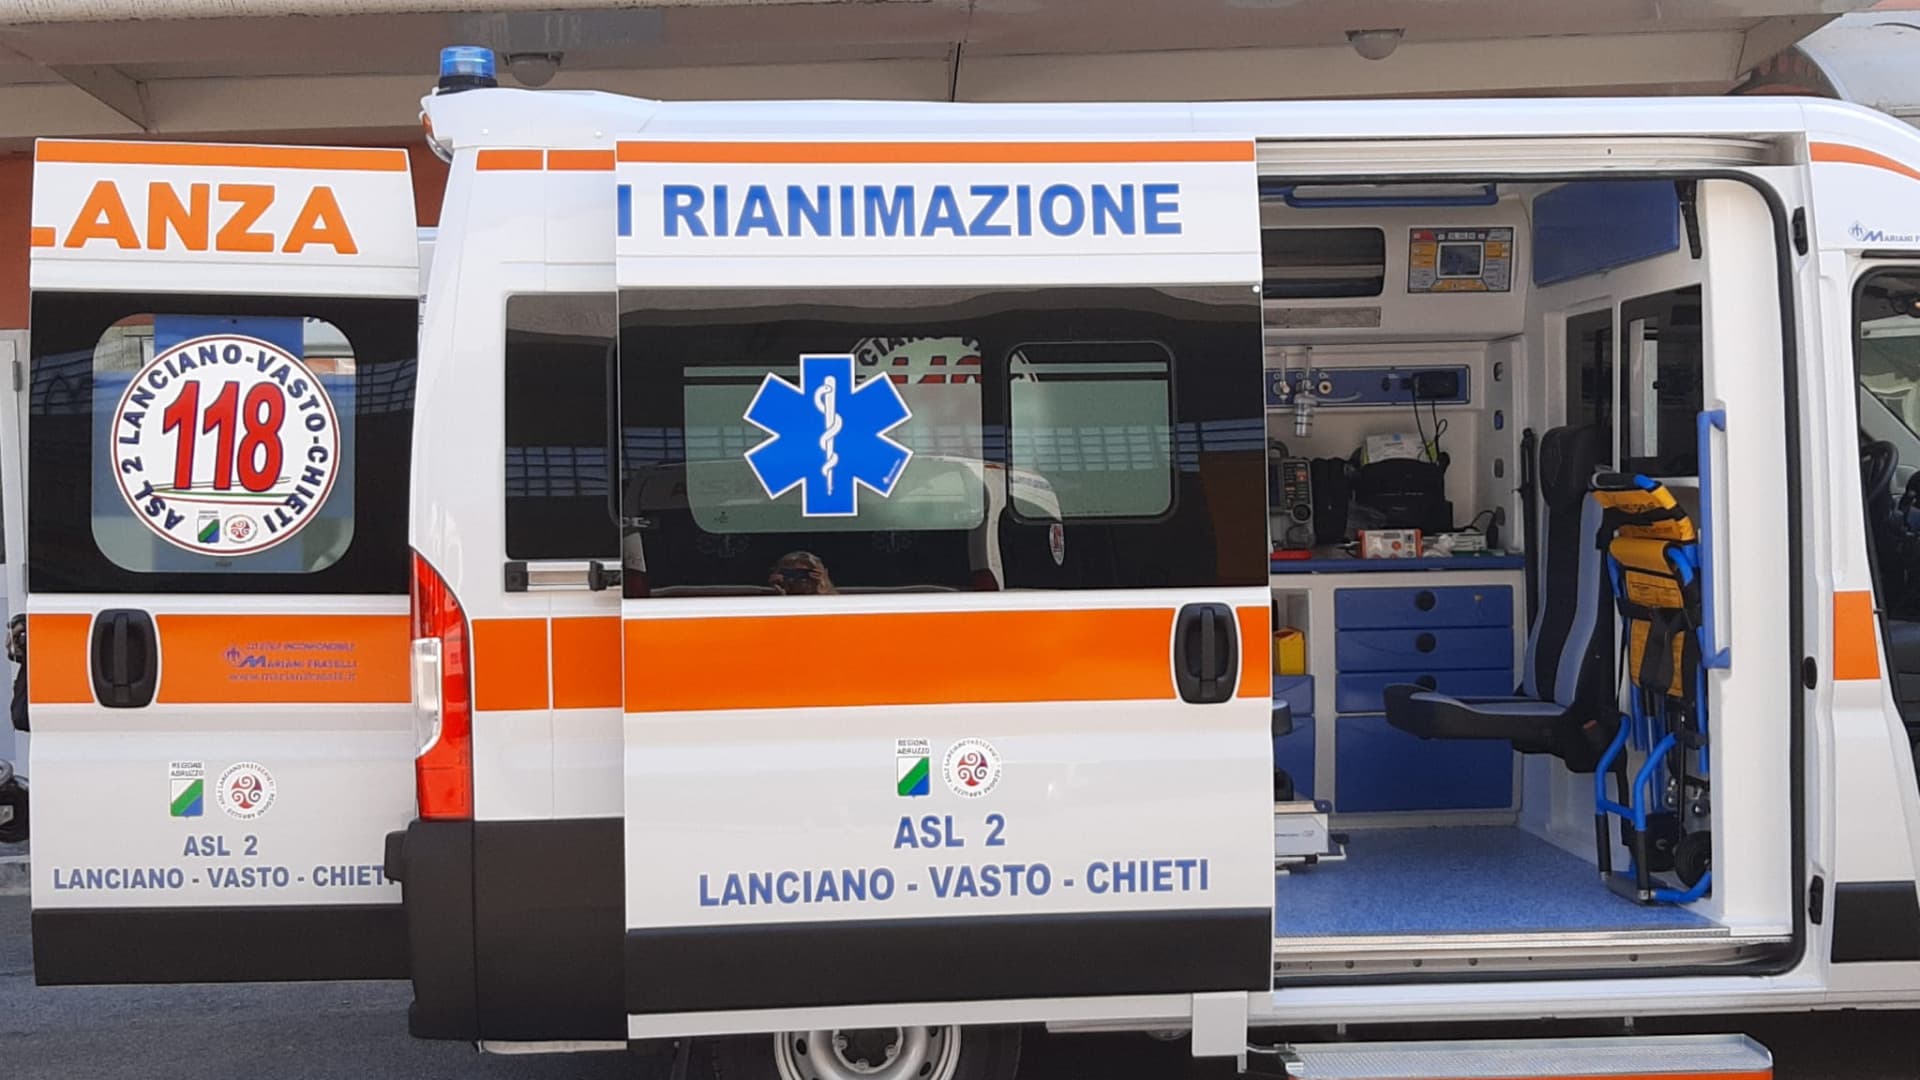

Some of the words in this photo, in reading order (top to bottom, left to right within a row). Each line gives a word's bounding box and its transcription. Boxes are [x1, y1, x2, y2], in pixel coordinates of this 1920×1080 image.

[663, 183, 1182, 237] RIANIMAZIONE
[162, 380, 286, 493] 118
[121, 456, 144, 474] 2
[133, 480, 185, 531] ASL
[183, 835, 231, 857] ASL
[244, 835, 258, 856] 2
[893, 815, 965, 849] ASL
[985, 813, 1005, 846] 2
[53, 868, 185, 890] LANCIANO
[207, 866, 290, 888] VASTO
[312, 865, 393, 887] CHIET
[699, 867, 895, 907] LANCIANO
[928, 863, 1051, 898] VASTO
[1086, 858, 1208, 894] CHIETI
